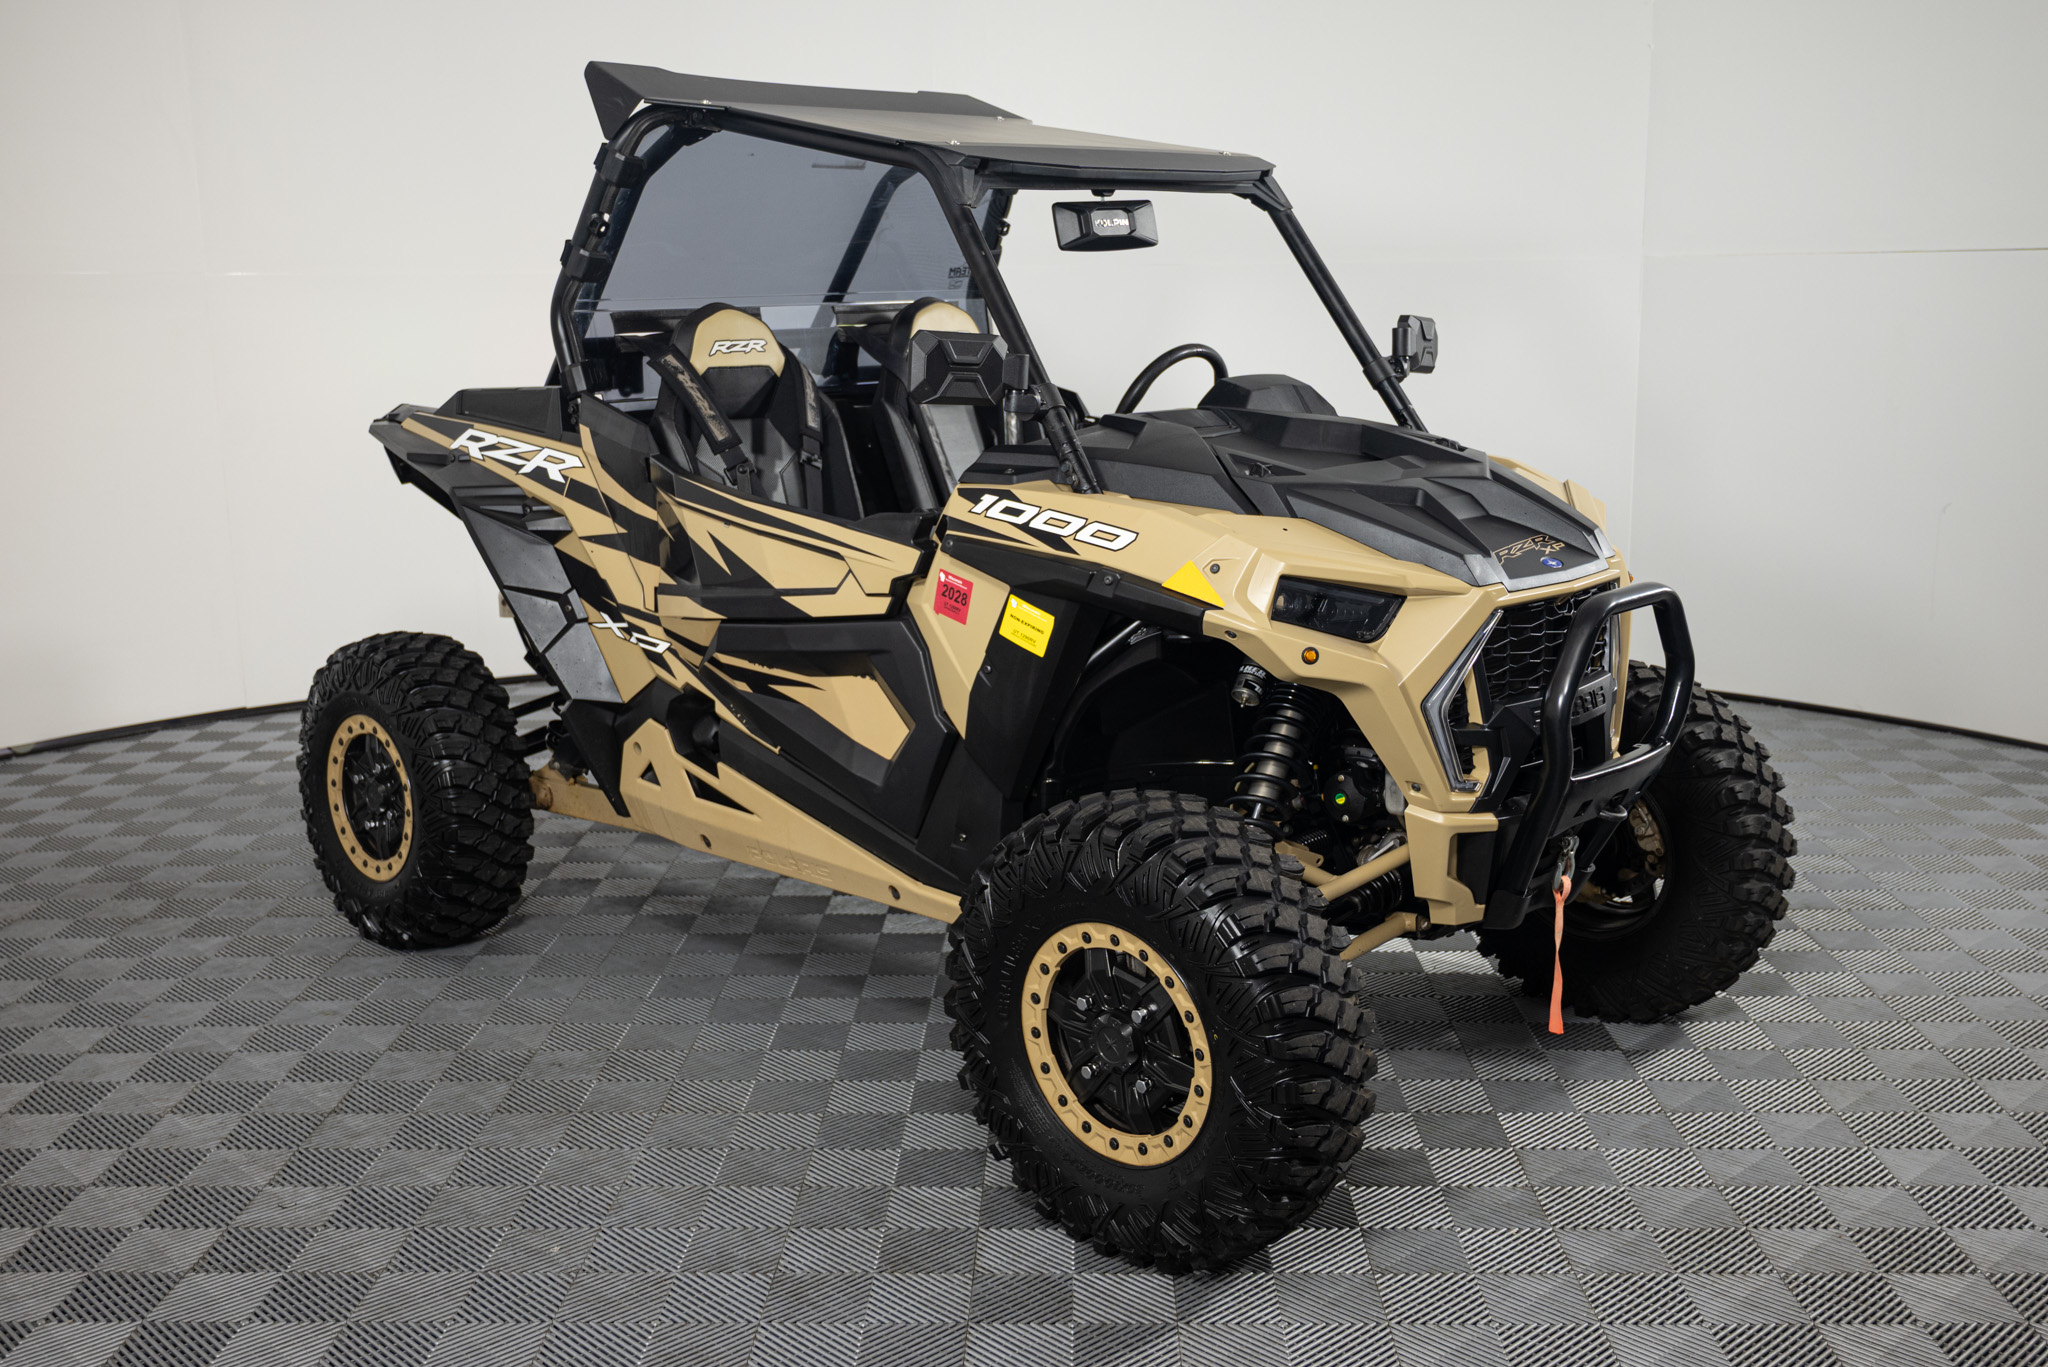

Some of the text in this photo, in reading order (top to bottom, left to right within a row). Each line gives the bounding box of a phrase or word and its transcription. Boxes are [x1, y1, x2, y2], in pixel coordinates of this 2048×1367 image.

[1094, 218, 1129, 228] KOLPIN
[709, 339, 767, 356] RZR
[449, 428, 584, 484] RZR
[969, 493, 1139, 551] 1000
[941, 584, 968, 606] 2028
